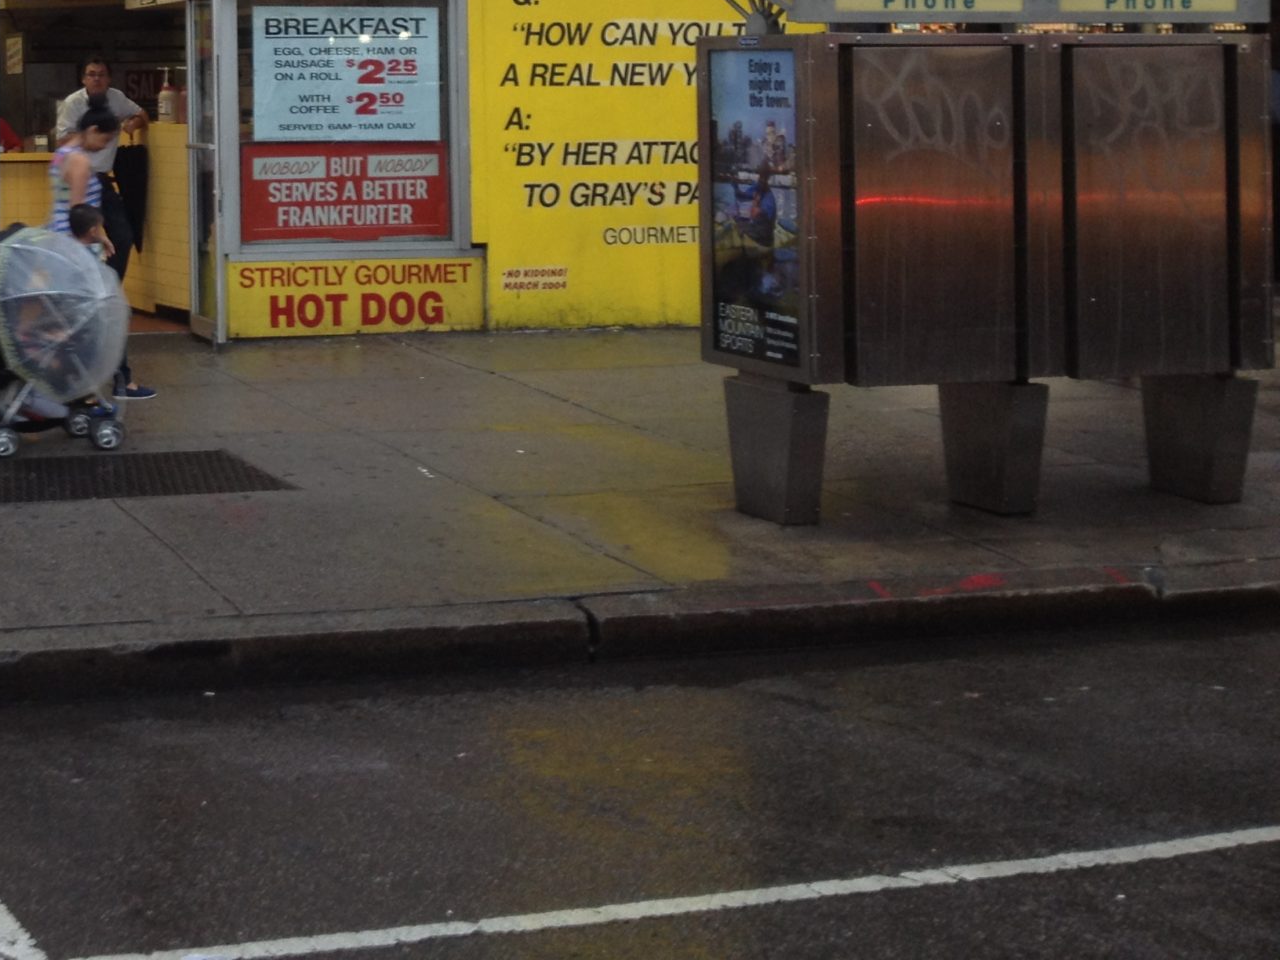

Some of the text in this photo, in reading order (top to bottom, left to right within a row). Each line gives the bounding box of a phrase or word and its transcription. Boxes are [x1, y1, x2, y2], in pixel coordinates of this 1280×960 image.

[264, 16, 427, 36] BREAKFAST
[601, 22, 658, 46] CAN
[366, 46, 396, 56] HAM
[398, 46, 418, 56] OR
[273, 58, 336, 70] SAUSAGE
[500, 63, 520, 87] A
[528, 63, 601, 87] REAL
[610, 63, 674, 86] NEW
[273, 71, 343, 82] ON A ROLL
[288, 105, 341, 115] COFFEE
[297, 94, 332, 104] WITH
[277, 123, 324, 132] SERVED
[386, 122, 416, 131] DAILY
[504, 106, 532, 131] A:
[562, 141, 618, 166] HER
[257, 156, 435, 177] NOBODY BUT NOBODY
[267, 178, 429, 203] SERVES A BETTER
[523, 183, 561, 208] TO
[570, 181, 667, 207] GRAY'S
[277, 203, 414, 228] FRANKFURTER
[602, 226, 699, 245] GOURMET
[238, 262, 473, 289] STRICTLY GOURMET
[269, 291, 445, 329] HOT DOG
